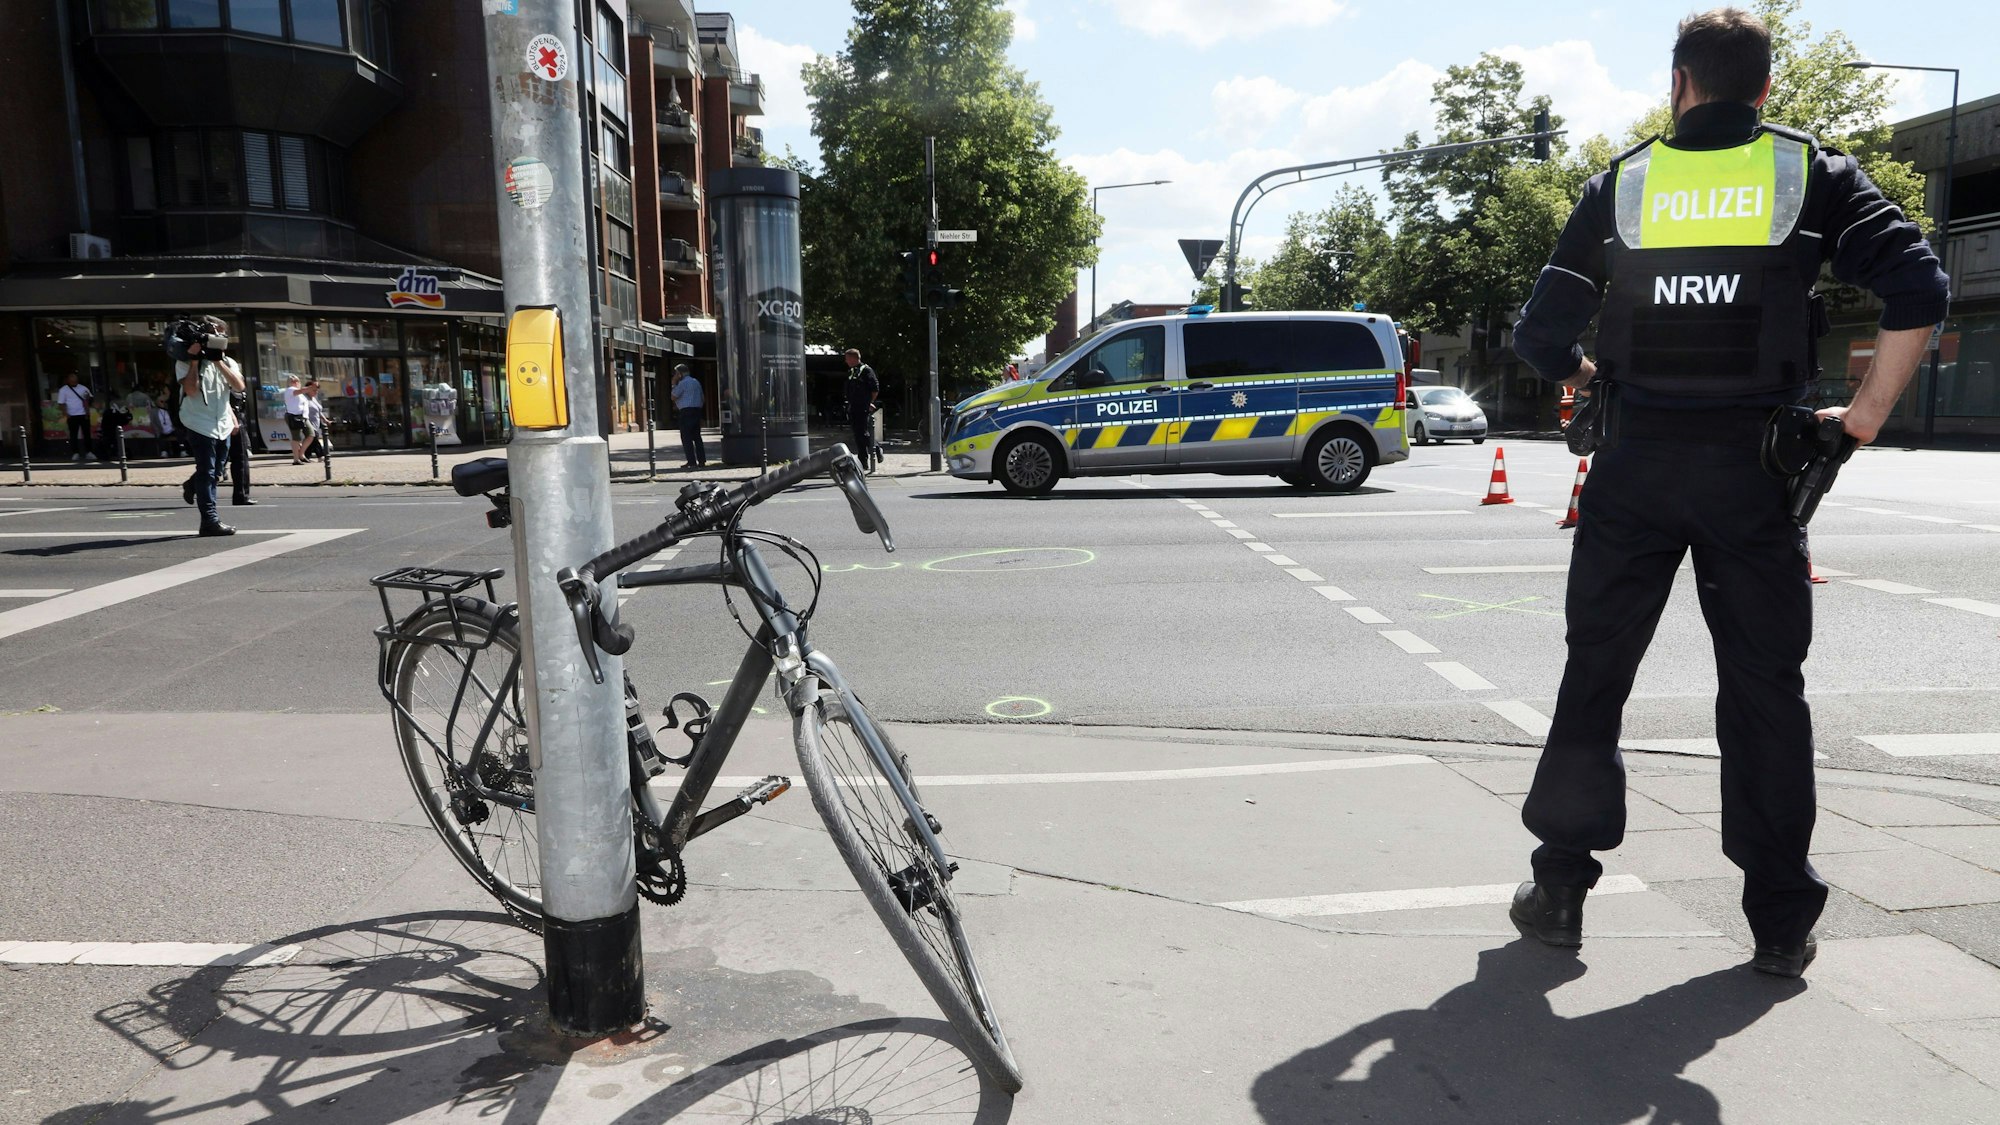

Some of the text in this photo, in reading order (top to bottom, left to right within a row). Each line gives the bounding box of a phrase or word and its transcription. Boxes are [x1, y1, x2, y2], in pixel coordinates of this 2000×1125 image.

[529, 37, 563, 71] BLUTSPENDER
[558, 54, 567, 75] 2024
[1651, 185, 1763, 223] POLIZEI
[940, 232, 973, 240] Niehler Str.
[398, 268, 438, 294] dm
[1654, 274, 1741, 304] NRW
[757, 299, 801, 318] XC60
[1096, 399, 1158, 416] POLIZEI
[271, 430, 287, 439] dm
